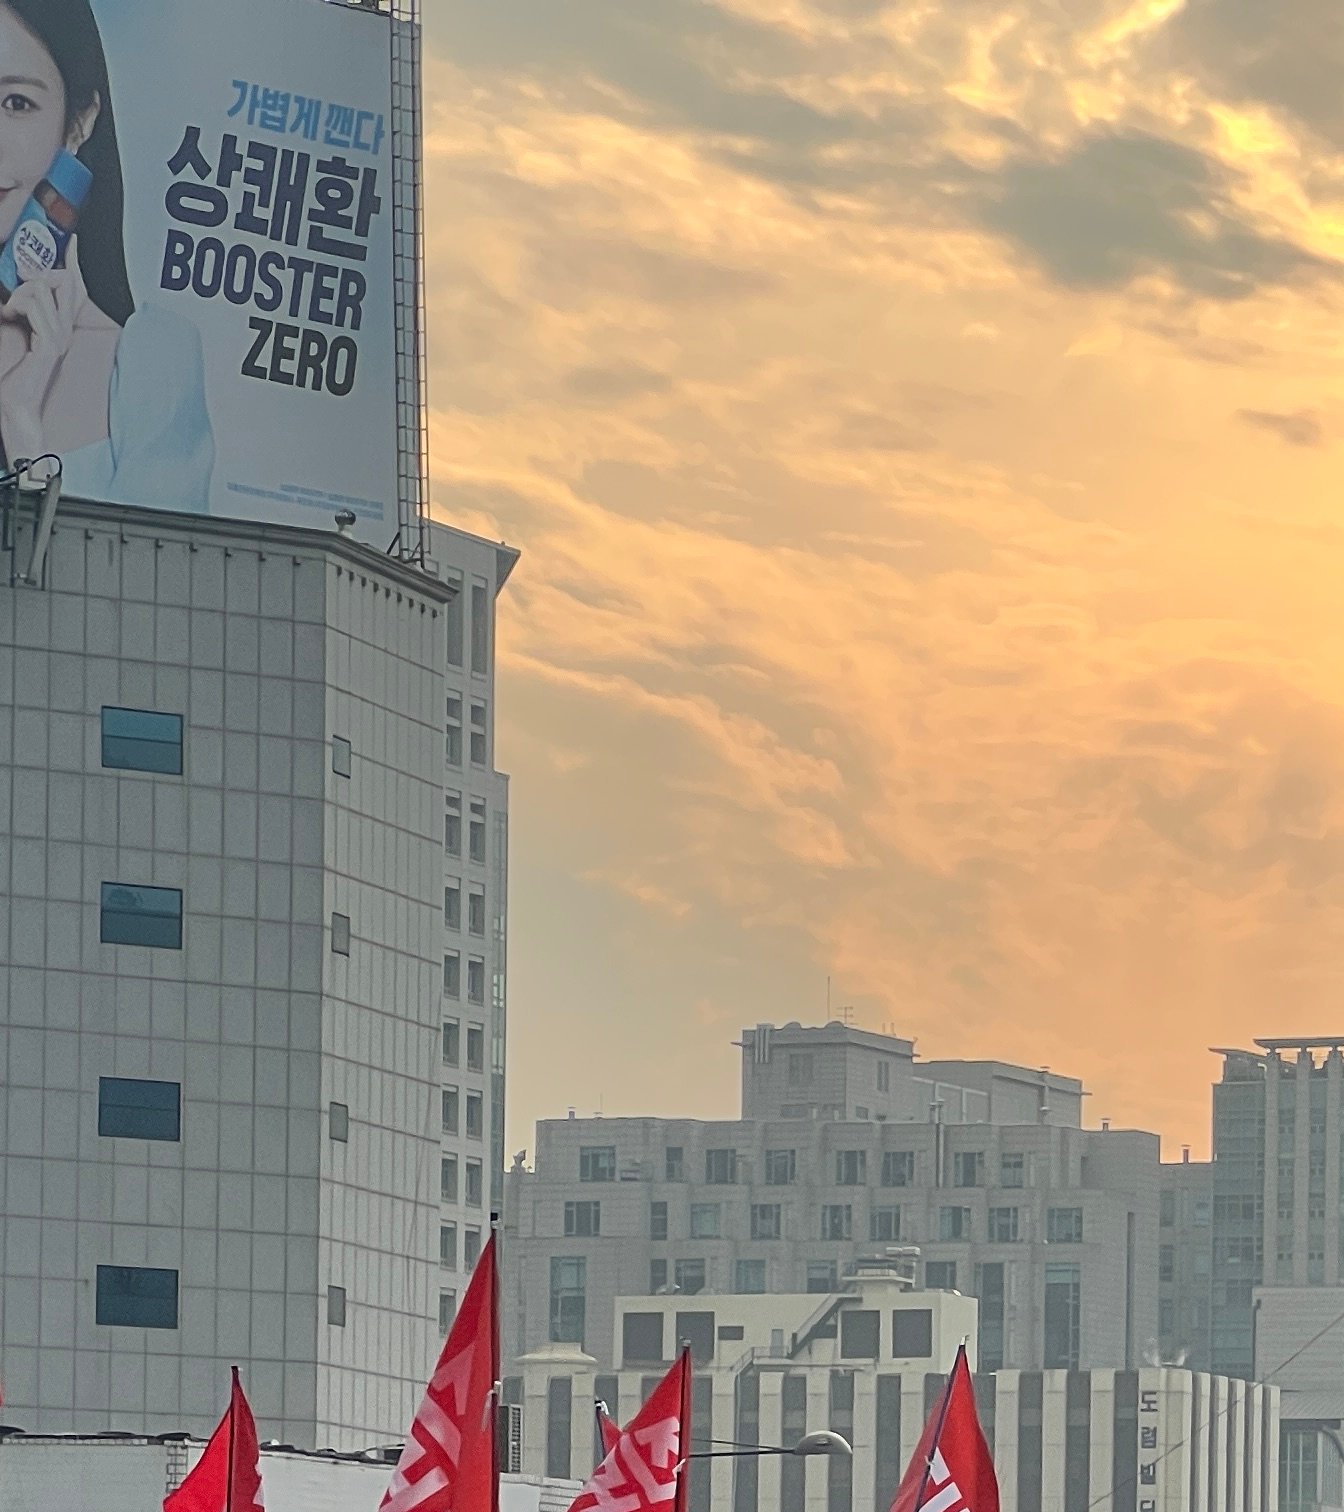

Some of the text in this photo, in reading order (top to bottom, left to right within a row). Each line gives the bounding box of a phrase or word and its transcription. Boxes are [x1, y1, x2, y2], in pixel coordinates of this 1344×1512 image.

[227, 79, 385, 155] 가볍게 깬다
[165, 126, 381, 261] 상쾌환
[160, 228, 367, 331] BOOSTER
[241, 315, 358, 397] ZERO
